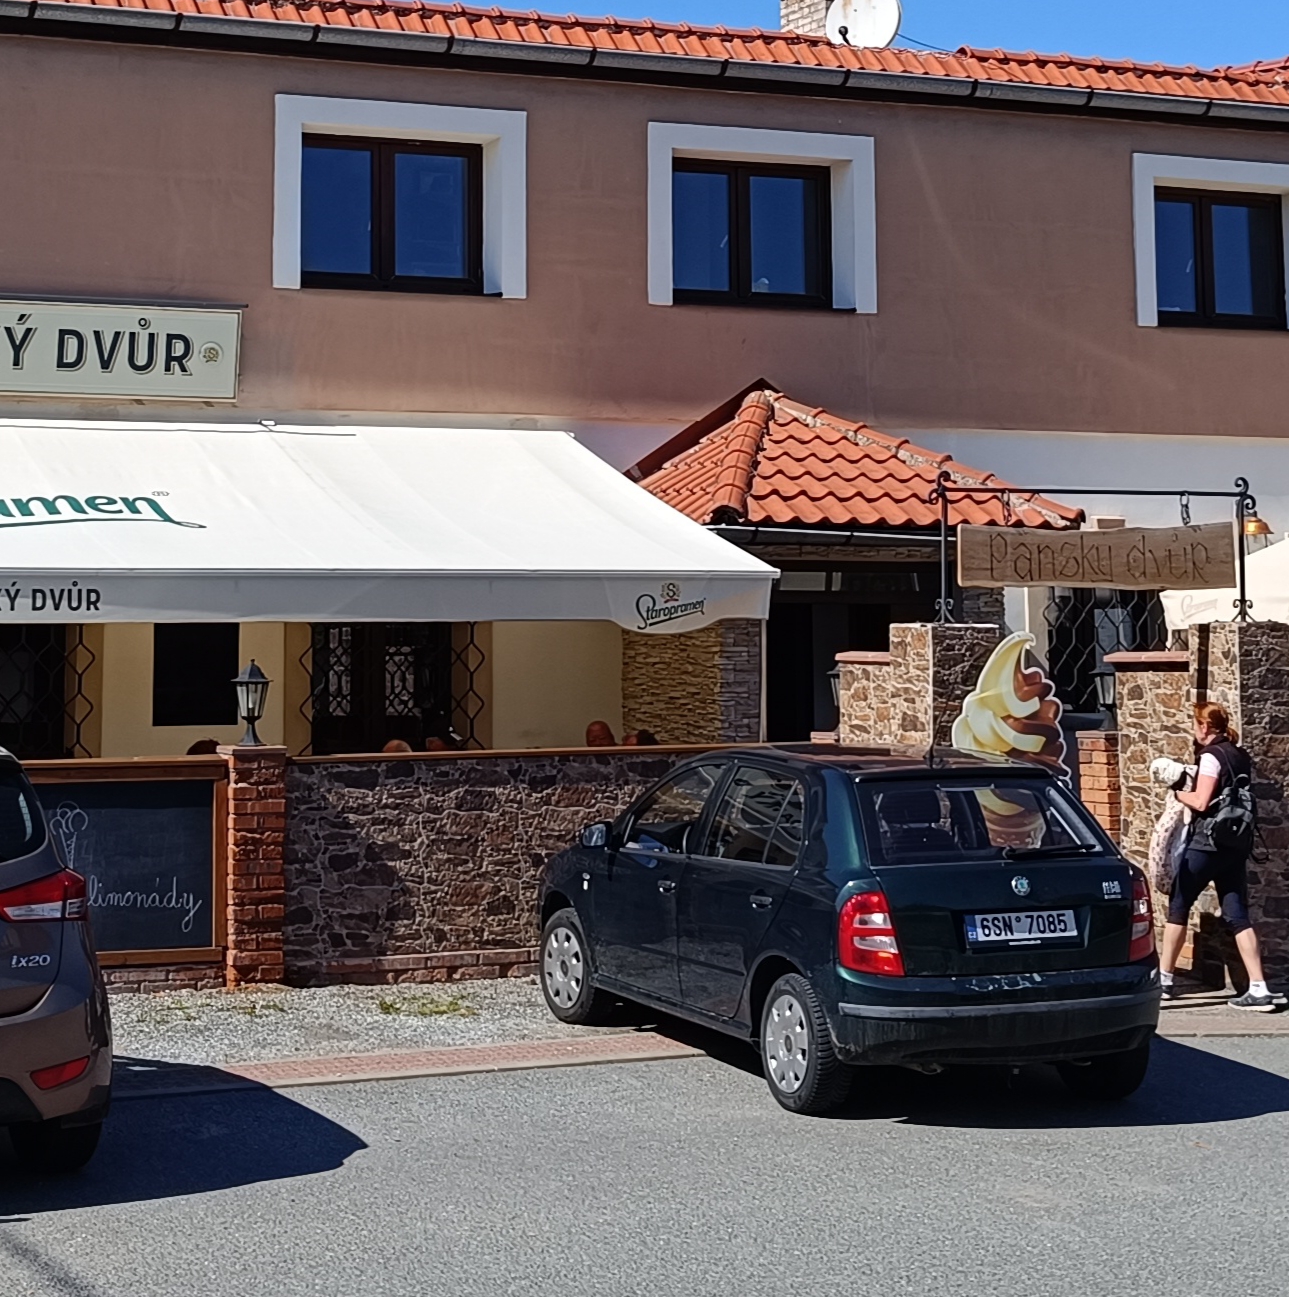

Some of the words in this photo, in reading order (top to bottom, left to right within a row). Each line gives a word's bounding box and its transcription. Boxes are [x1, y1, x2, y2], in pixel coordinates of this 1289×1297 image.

[56, 317, 193, 376] DVŮR
[31, 580, 101, 611] DVŮR
[635, 594, 705, 630] Staropramen
[87, 875, 202, 932] limonády
[981, 916, 1014, 937] 6SN
[1025, 913, 1067, 935] 7085
[11, 954, 51, 968] ix20
